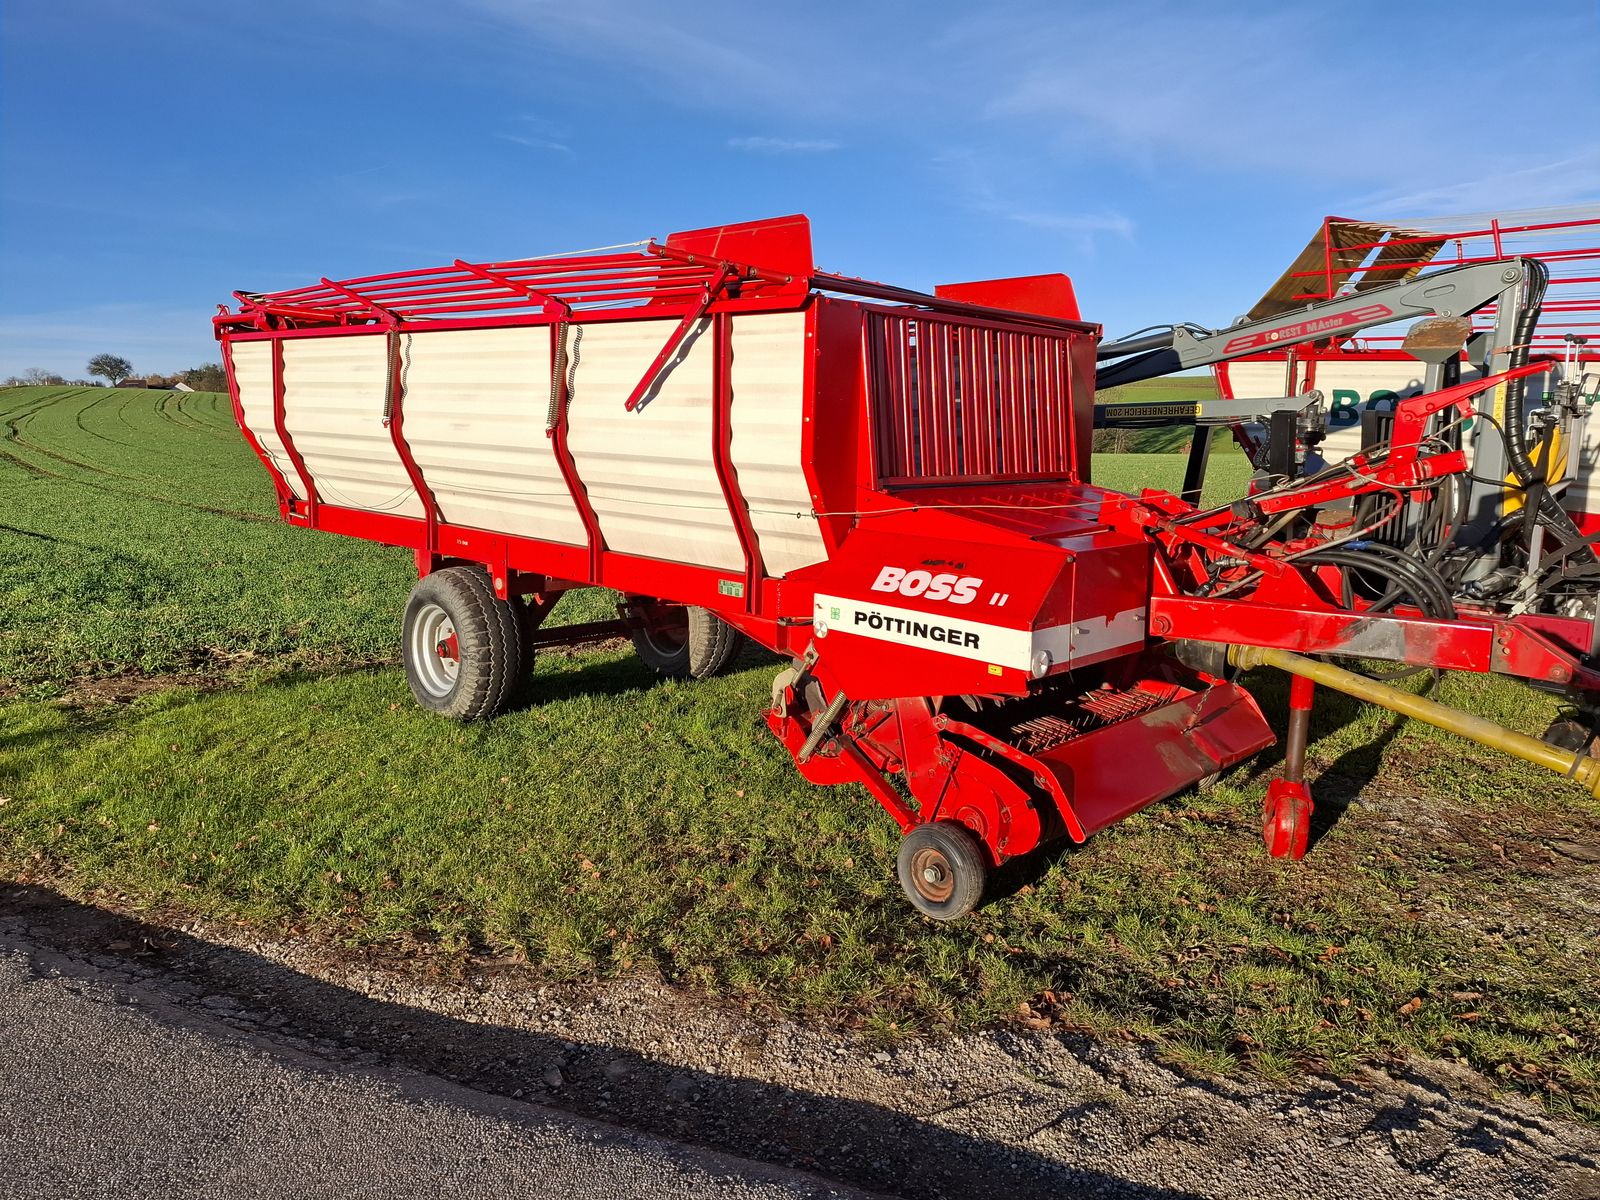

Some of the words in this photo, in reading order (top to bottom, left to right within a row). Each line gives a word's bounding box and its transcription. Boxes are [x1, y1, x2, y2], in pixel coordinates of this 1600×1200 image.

[1264, 326, 1302, 342] FOREST
[1106, 407, 1122, 417] 20M
[1124, 405, 1201, 416] GEFAHRENBEREICH
[870, 566, 984, 605] BOSS
[854, 610, 981, 650] PÖTTINGER
